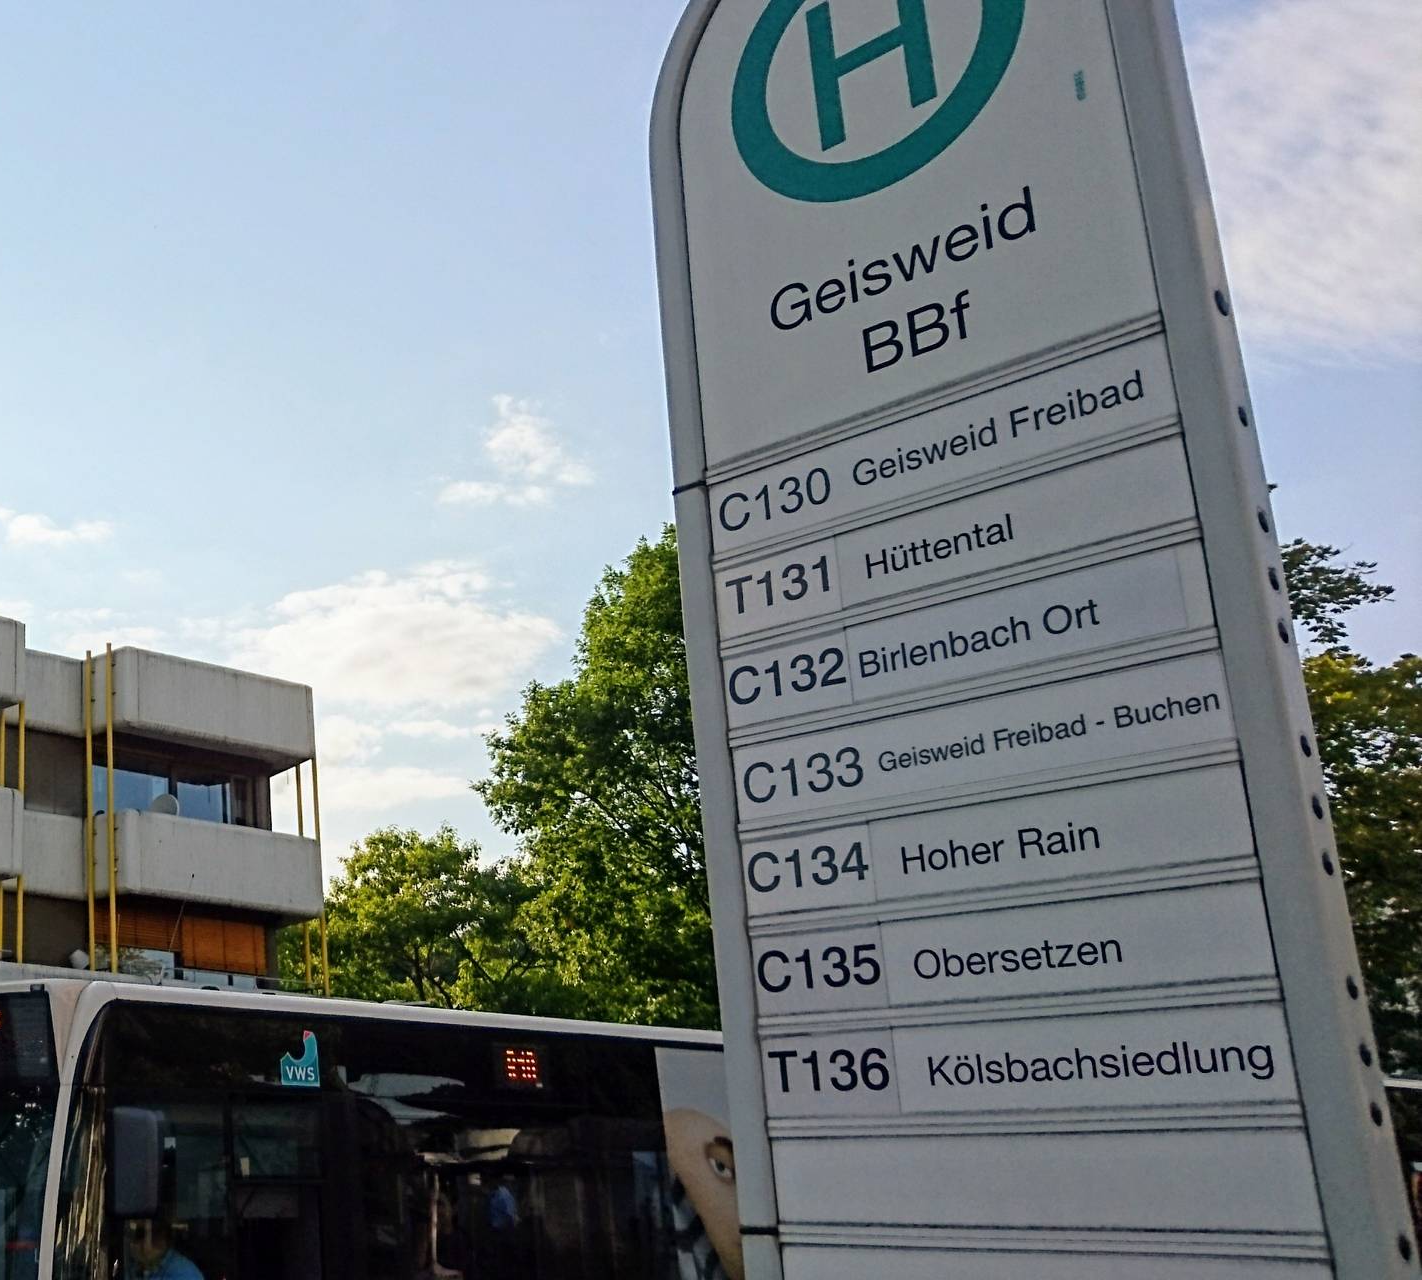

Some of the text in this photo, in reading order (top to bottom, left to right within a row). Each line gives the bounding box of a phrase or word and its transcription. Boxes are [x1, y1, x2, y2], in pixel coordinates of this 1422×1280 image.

[806, 0, 938, 151] H
[770, 185, 1037, 331] Geisweid
[861, 290, 971, 374] BBf
[719, 368, 1145, 532] C130 Geisweid Freibad
[725, 512, 1015, 615] T131 Hüttental
[728, 598, 1101, 705] C132 Birlenbach Ort
[743, 692, 1220, 804] C133 Geisweid Freibad - Buchen
[747, 822, 1101, 893] C134 Hoher Rain
[757, 937, 1124, 993] C135 Obersetzen
[285, 1065, 316, 1081] VWS
[767, 1039, 1276, 1093] T136 Kölsbachsiedlung
